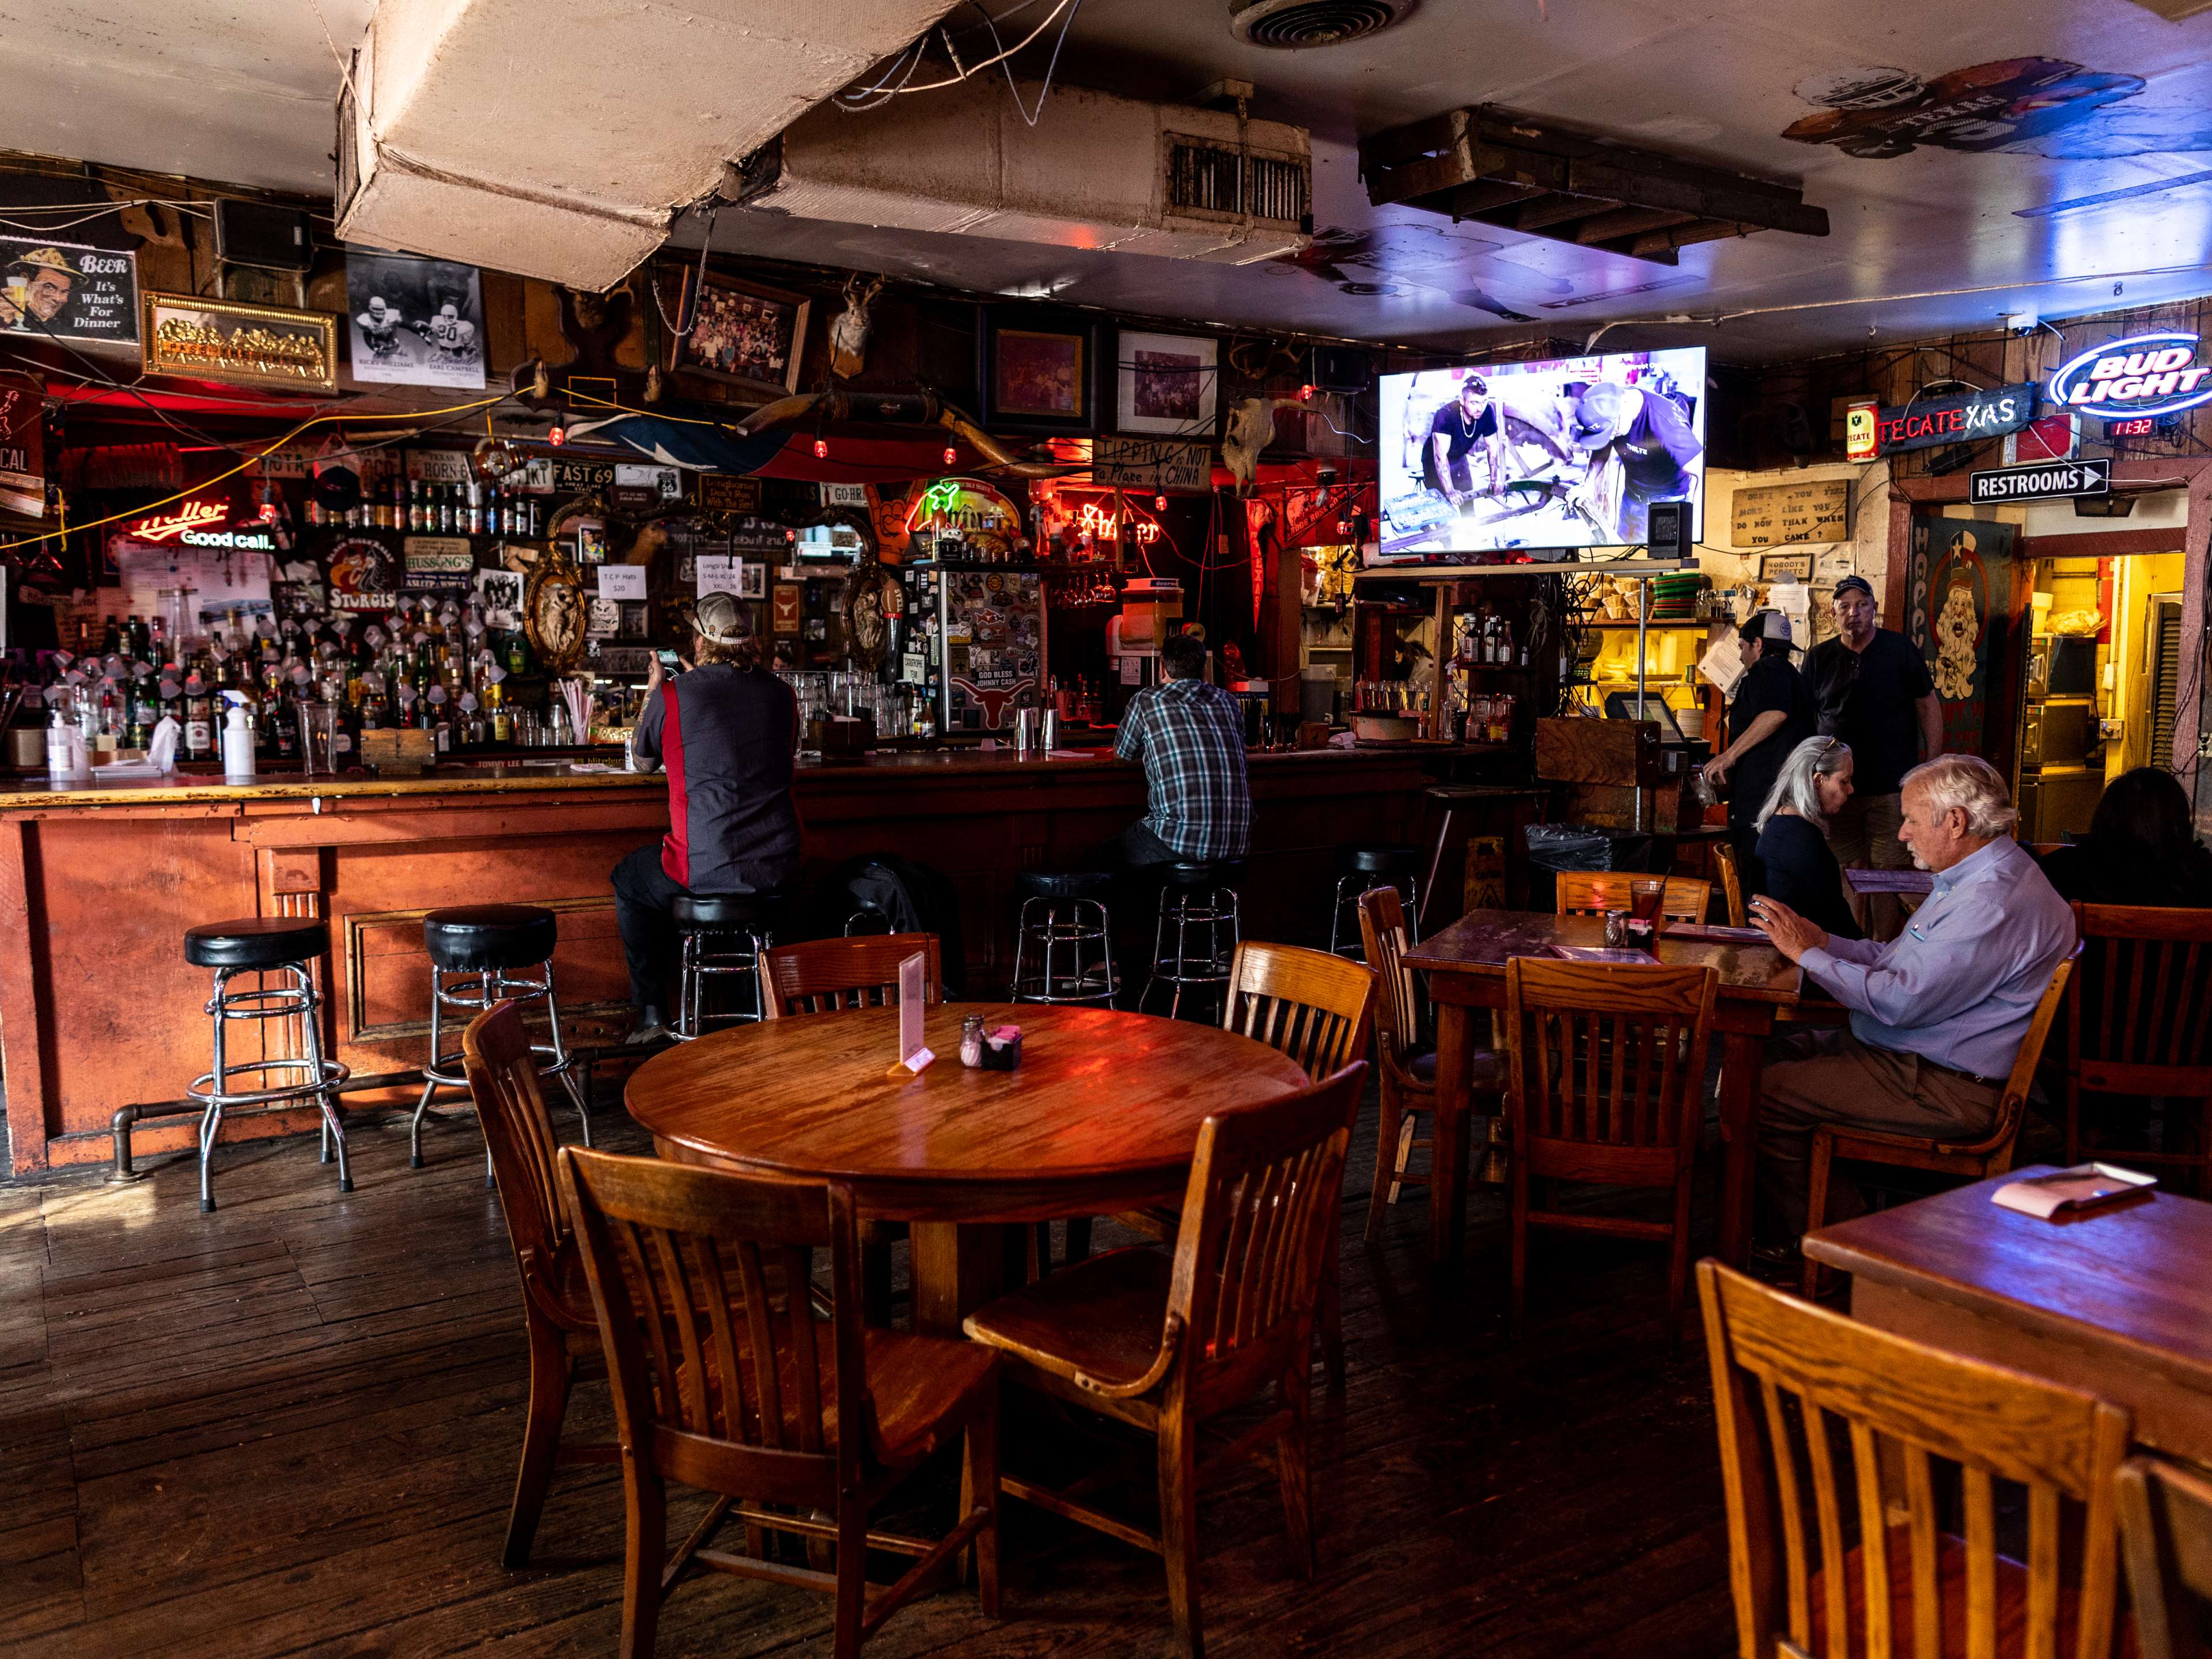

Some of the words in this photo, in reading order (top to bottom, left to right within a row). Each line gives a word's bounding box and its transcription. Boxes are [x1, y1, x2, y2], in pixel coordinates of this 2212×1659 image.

[1895, 94, 2008, 126] TEXAS
[79, 255, 127, 274] BEER
[96, 281, 116, 291] It's
[81, 293, 124, 304] What's
[89, 306, 113, 317] For
[73, 317, 121, 328] Dinner
[438, 324, 457, 342] 20
[171, 344, 209, 355] PASS
[2090, 347, 2194, 381] BUD
[2069, 366, 2211, 405] LIGHT
[2116, 419, 2152, 435] 11:32
[1099, 438, 1173, 464] TIPPING
[1187, 446, 1210, 467] NOT
[553, 464, 592, 482] FAST
[594, 469, 613, 483] 69
[1099, 470, 1105, 480] a
[1110, 463, 1142, 483] Place
[1150, 469, 1161, 484] in
[1165, 466, 1199, 486] CHINA
[662, 483, 673, 491] 66
[1978, 469, 2079, 498] RESTROOMS
[710, 488, 733, 497] Don't
[734, 490, 750, 498] Run
[1747, 492, 1773, 500] DON'T
[1794, 490, 1813, 499] YOU
[1824, 487, 1846, 496] FEEL
[706, 497, 723, 505] With
[724, 498, 737, 507] The
[1782, 505, 1804, 514] LIKE
[1812, 503, 1831, 512] YOU
[1754, 520, 1772, 528] NOW
[1782, 517, 1808, 527] THAN
[1816, 514, 1844, 523] WHEN
[180, 529, 233, 547] Good
[1752, 536, 1769, 544] YOU
[1785, 533, 1810, 541] CAME
[329, 588, 396, 608] STURGIS
[894, 589, 903, 612] TEXAS
[993, 671, 1013, 679] BLESS
